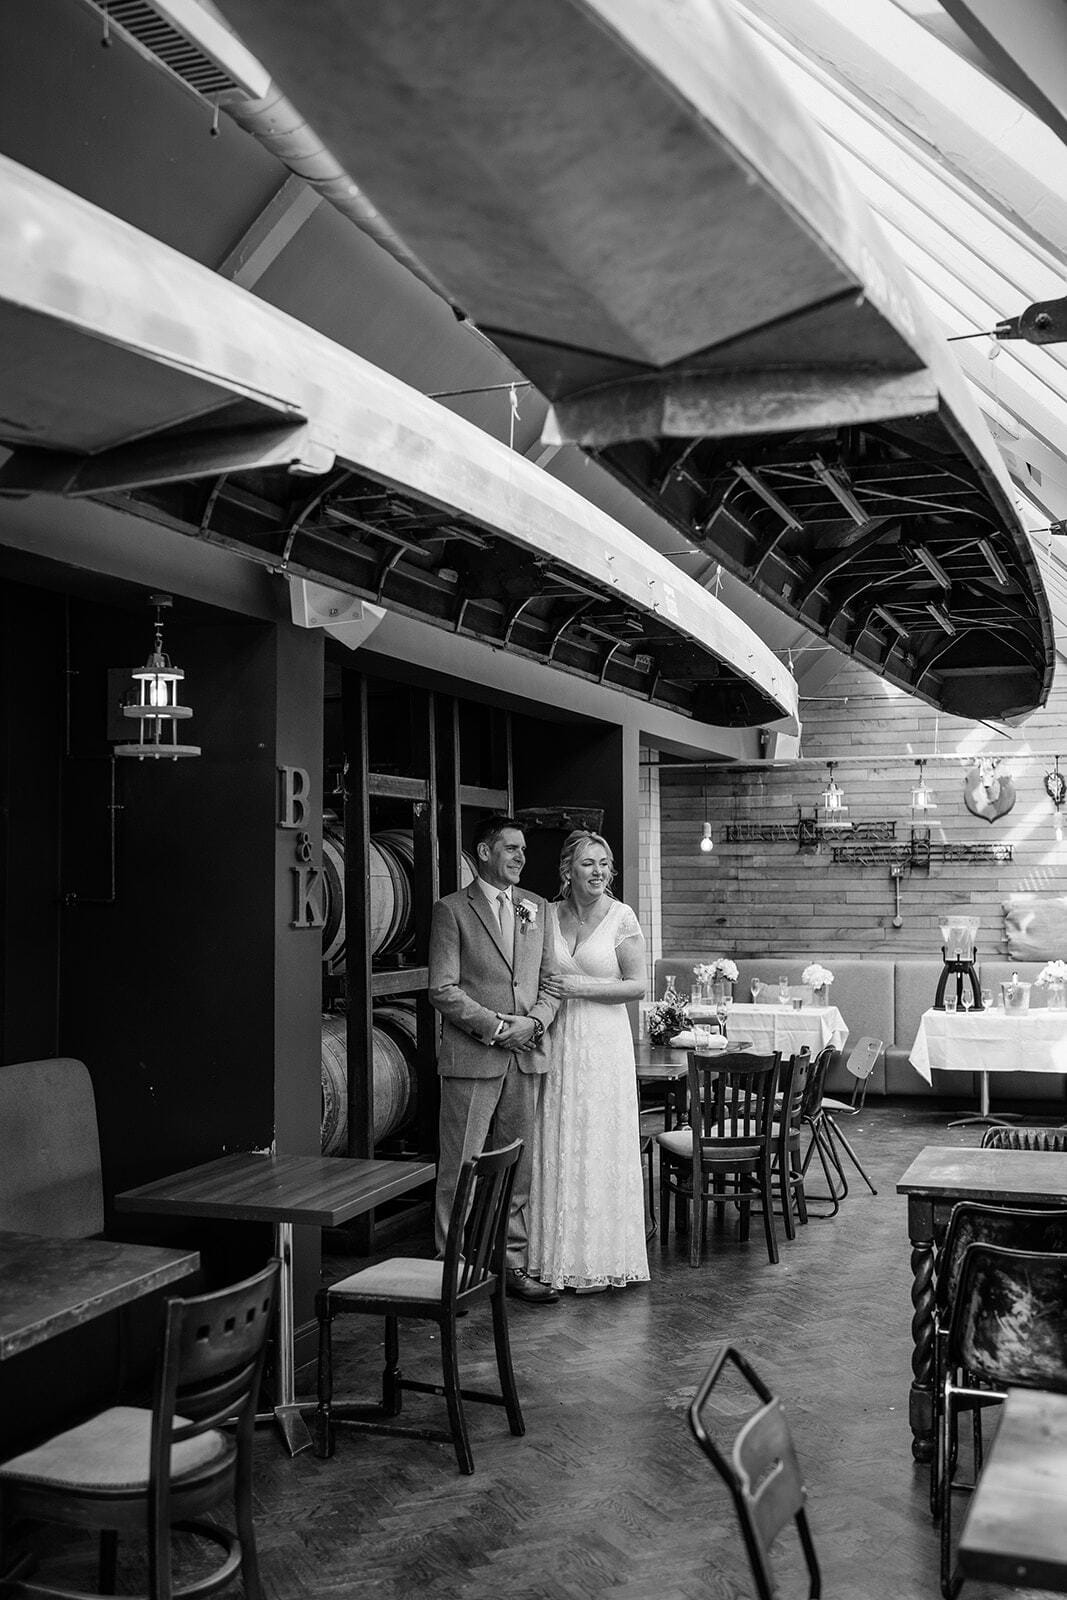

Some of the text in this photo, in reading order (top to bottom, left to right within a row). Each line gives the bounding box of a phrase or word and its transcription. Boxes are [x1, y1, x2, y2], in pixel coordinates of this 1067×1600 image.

[278, 765, 326, 928] B & K
